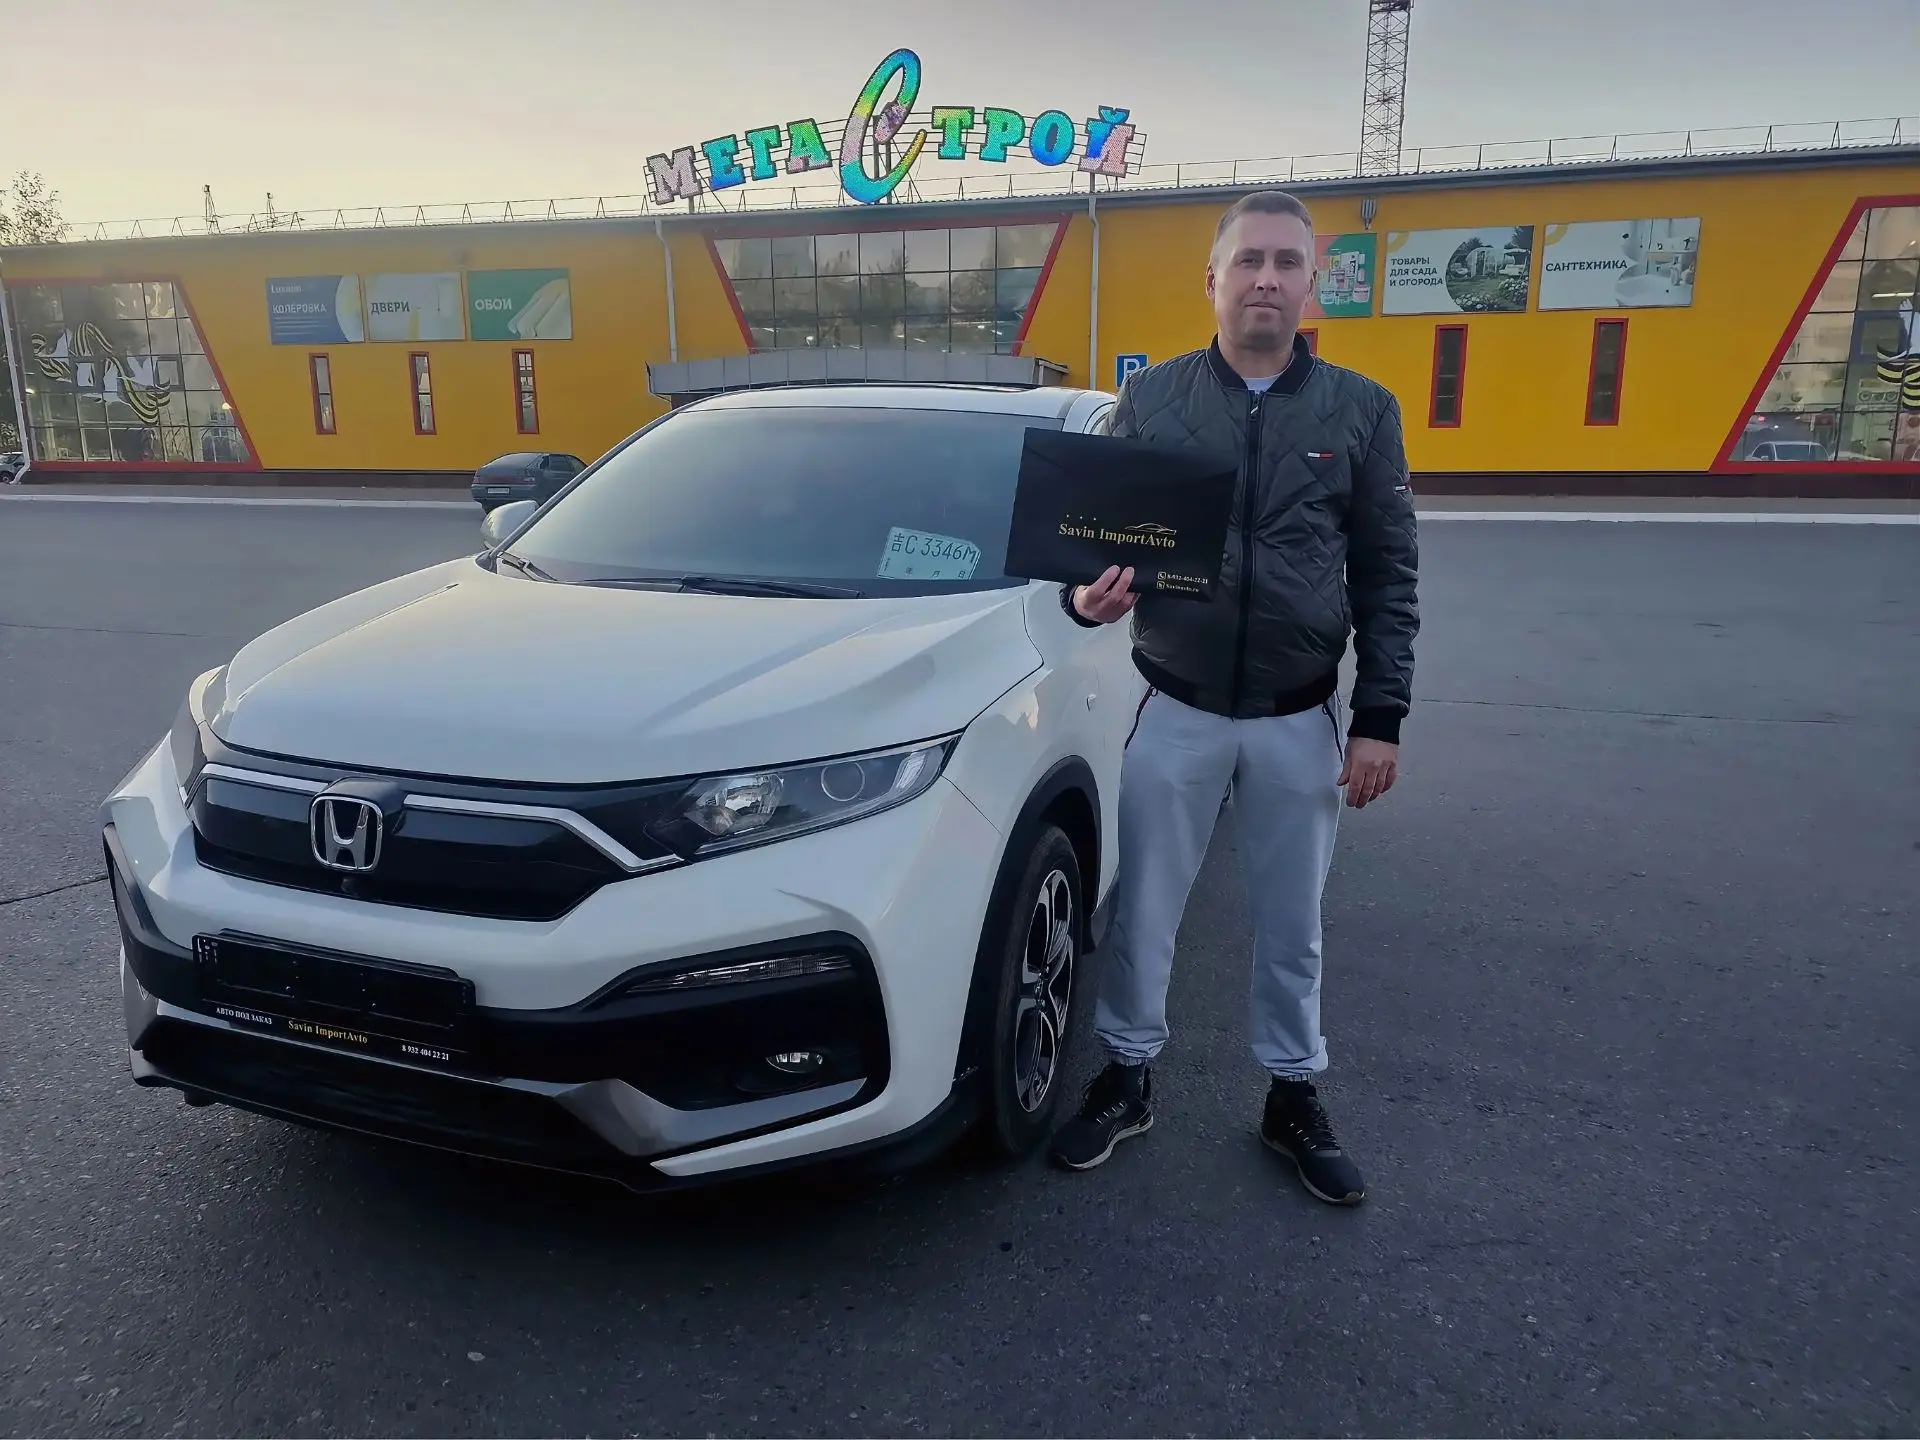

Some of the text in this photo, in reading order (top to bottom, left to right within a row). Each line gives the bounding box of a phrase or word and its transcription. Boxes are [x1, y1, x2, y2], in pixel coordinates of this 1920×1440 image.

[1390, 257, 1430, 266] ТОВАРЫ
[1545, 259, 1628, 272] САНТЕХНИКА
[1389, 267, 1437, 277] ДЛЯ САДА
[1398, 277, 1444, 287] ОГОРОДА
[272, 302, 327, 314] КОЛЕРОВКА
[371, 301, 410, 314] ДВЕРИ
[474, 298, 512, 311] ОБОИ
[1058, 523, 1176, 548] Savin ImportAvto
[216, 1007, 273, 1025] АВТО ПОД ЗАКАЗ
[288, 1020, 368, 1044] Savin ImportAvto
[407, 1046, 419, 1055] 932
[420, 1048, 432, 1057] 404
[432, 1050, 441, 1058] 22
[441, 1052, 449, 1061] 21
